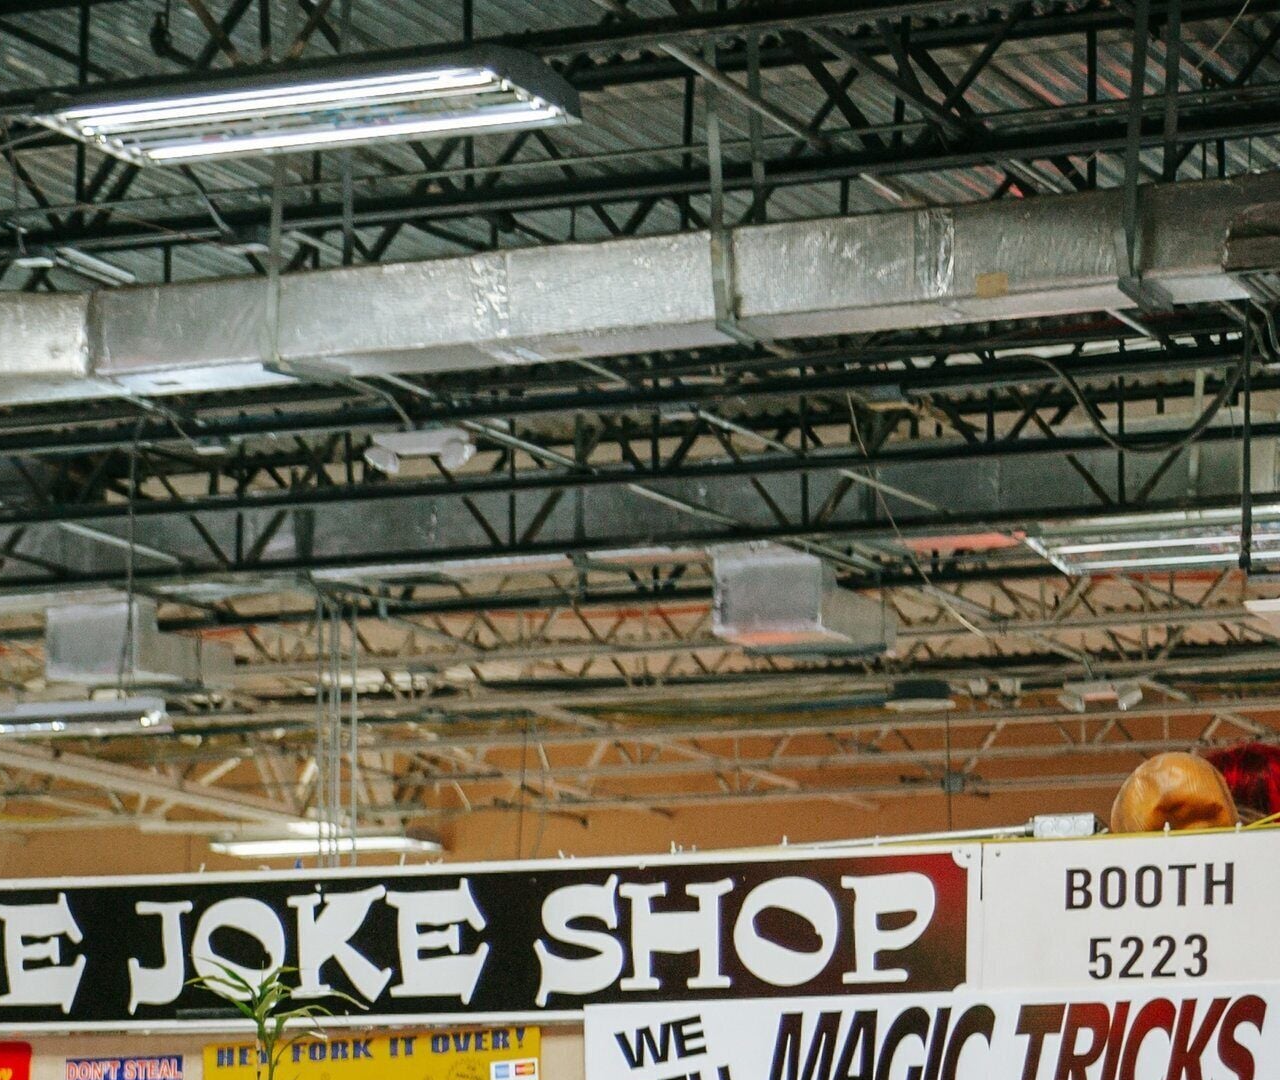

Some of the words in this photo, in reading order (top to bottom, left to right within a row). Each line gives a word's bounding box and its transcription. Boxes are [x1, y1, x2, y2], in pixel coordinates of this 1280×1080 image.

[1062, 860, 1236, 912] BOOTH
[129, 876, 490, 1015] JOKE
[533, 870, 938, 1007] SHOP
[1086, 932, 1210, 982] 5223
[291, 1037, 375, 1064] FORK
[389, 1035, 419, 1058] IT
[430, 1027, 526, 1054] OVER!
[613, 1014, 707, 1071] WE
